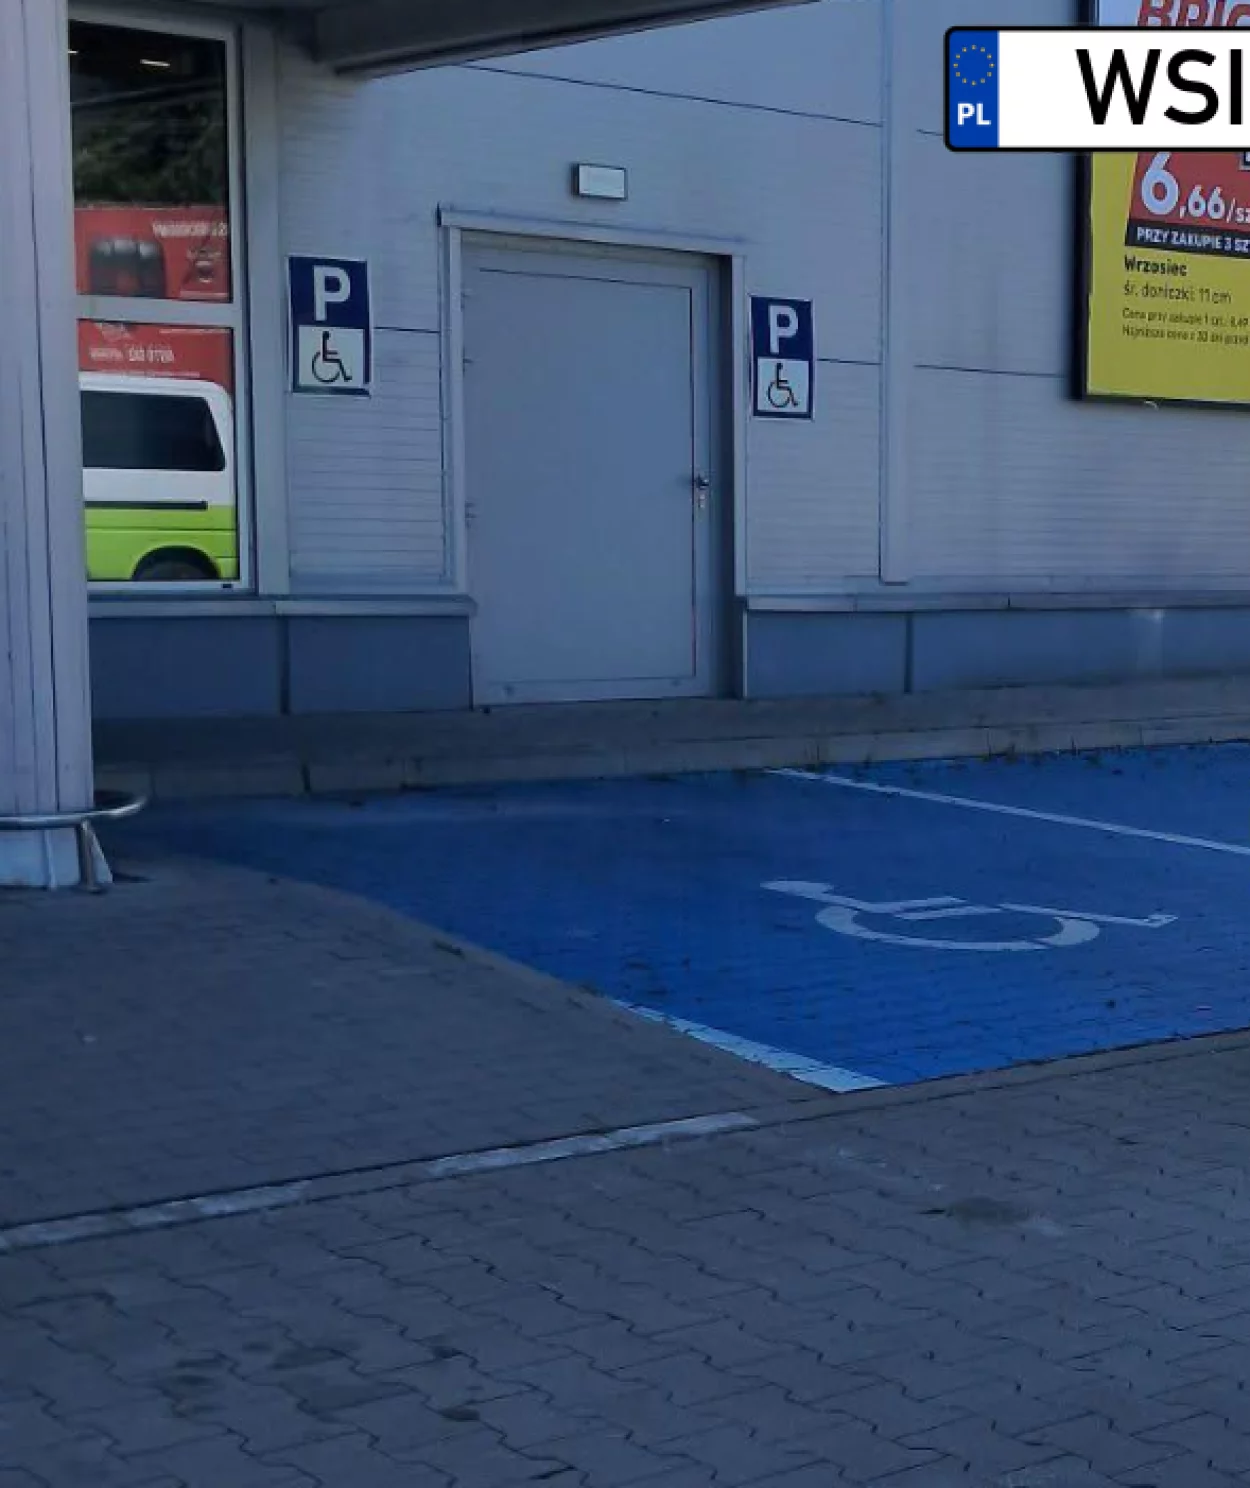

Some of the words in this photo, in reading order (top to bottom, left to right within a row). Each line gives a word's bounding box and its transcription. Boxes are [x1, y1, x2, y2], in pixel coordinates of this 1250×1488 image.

[1136, 226, 1169, 243] PRZY
[1172, 230, 1223, 250] ZAKUPIE
[1224, 237, 1232, 251] 3
[1124, 254, 1187, 276] Wrzosiec
[312, 265, 351, 322] P
[768, 304, 799, 355] P
